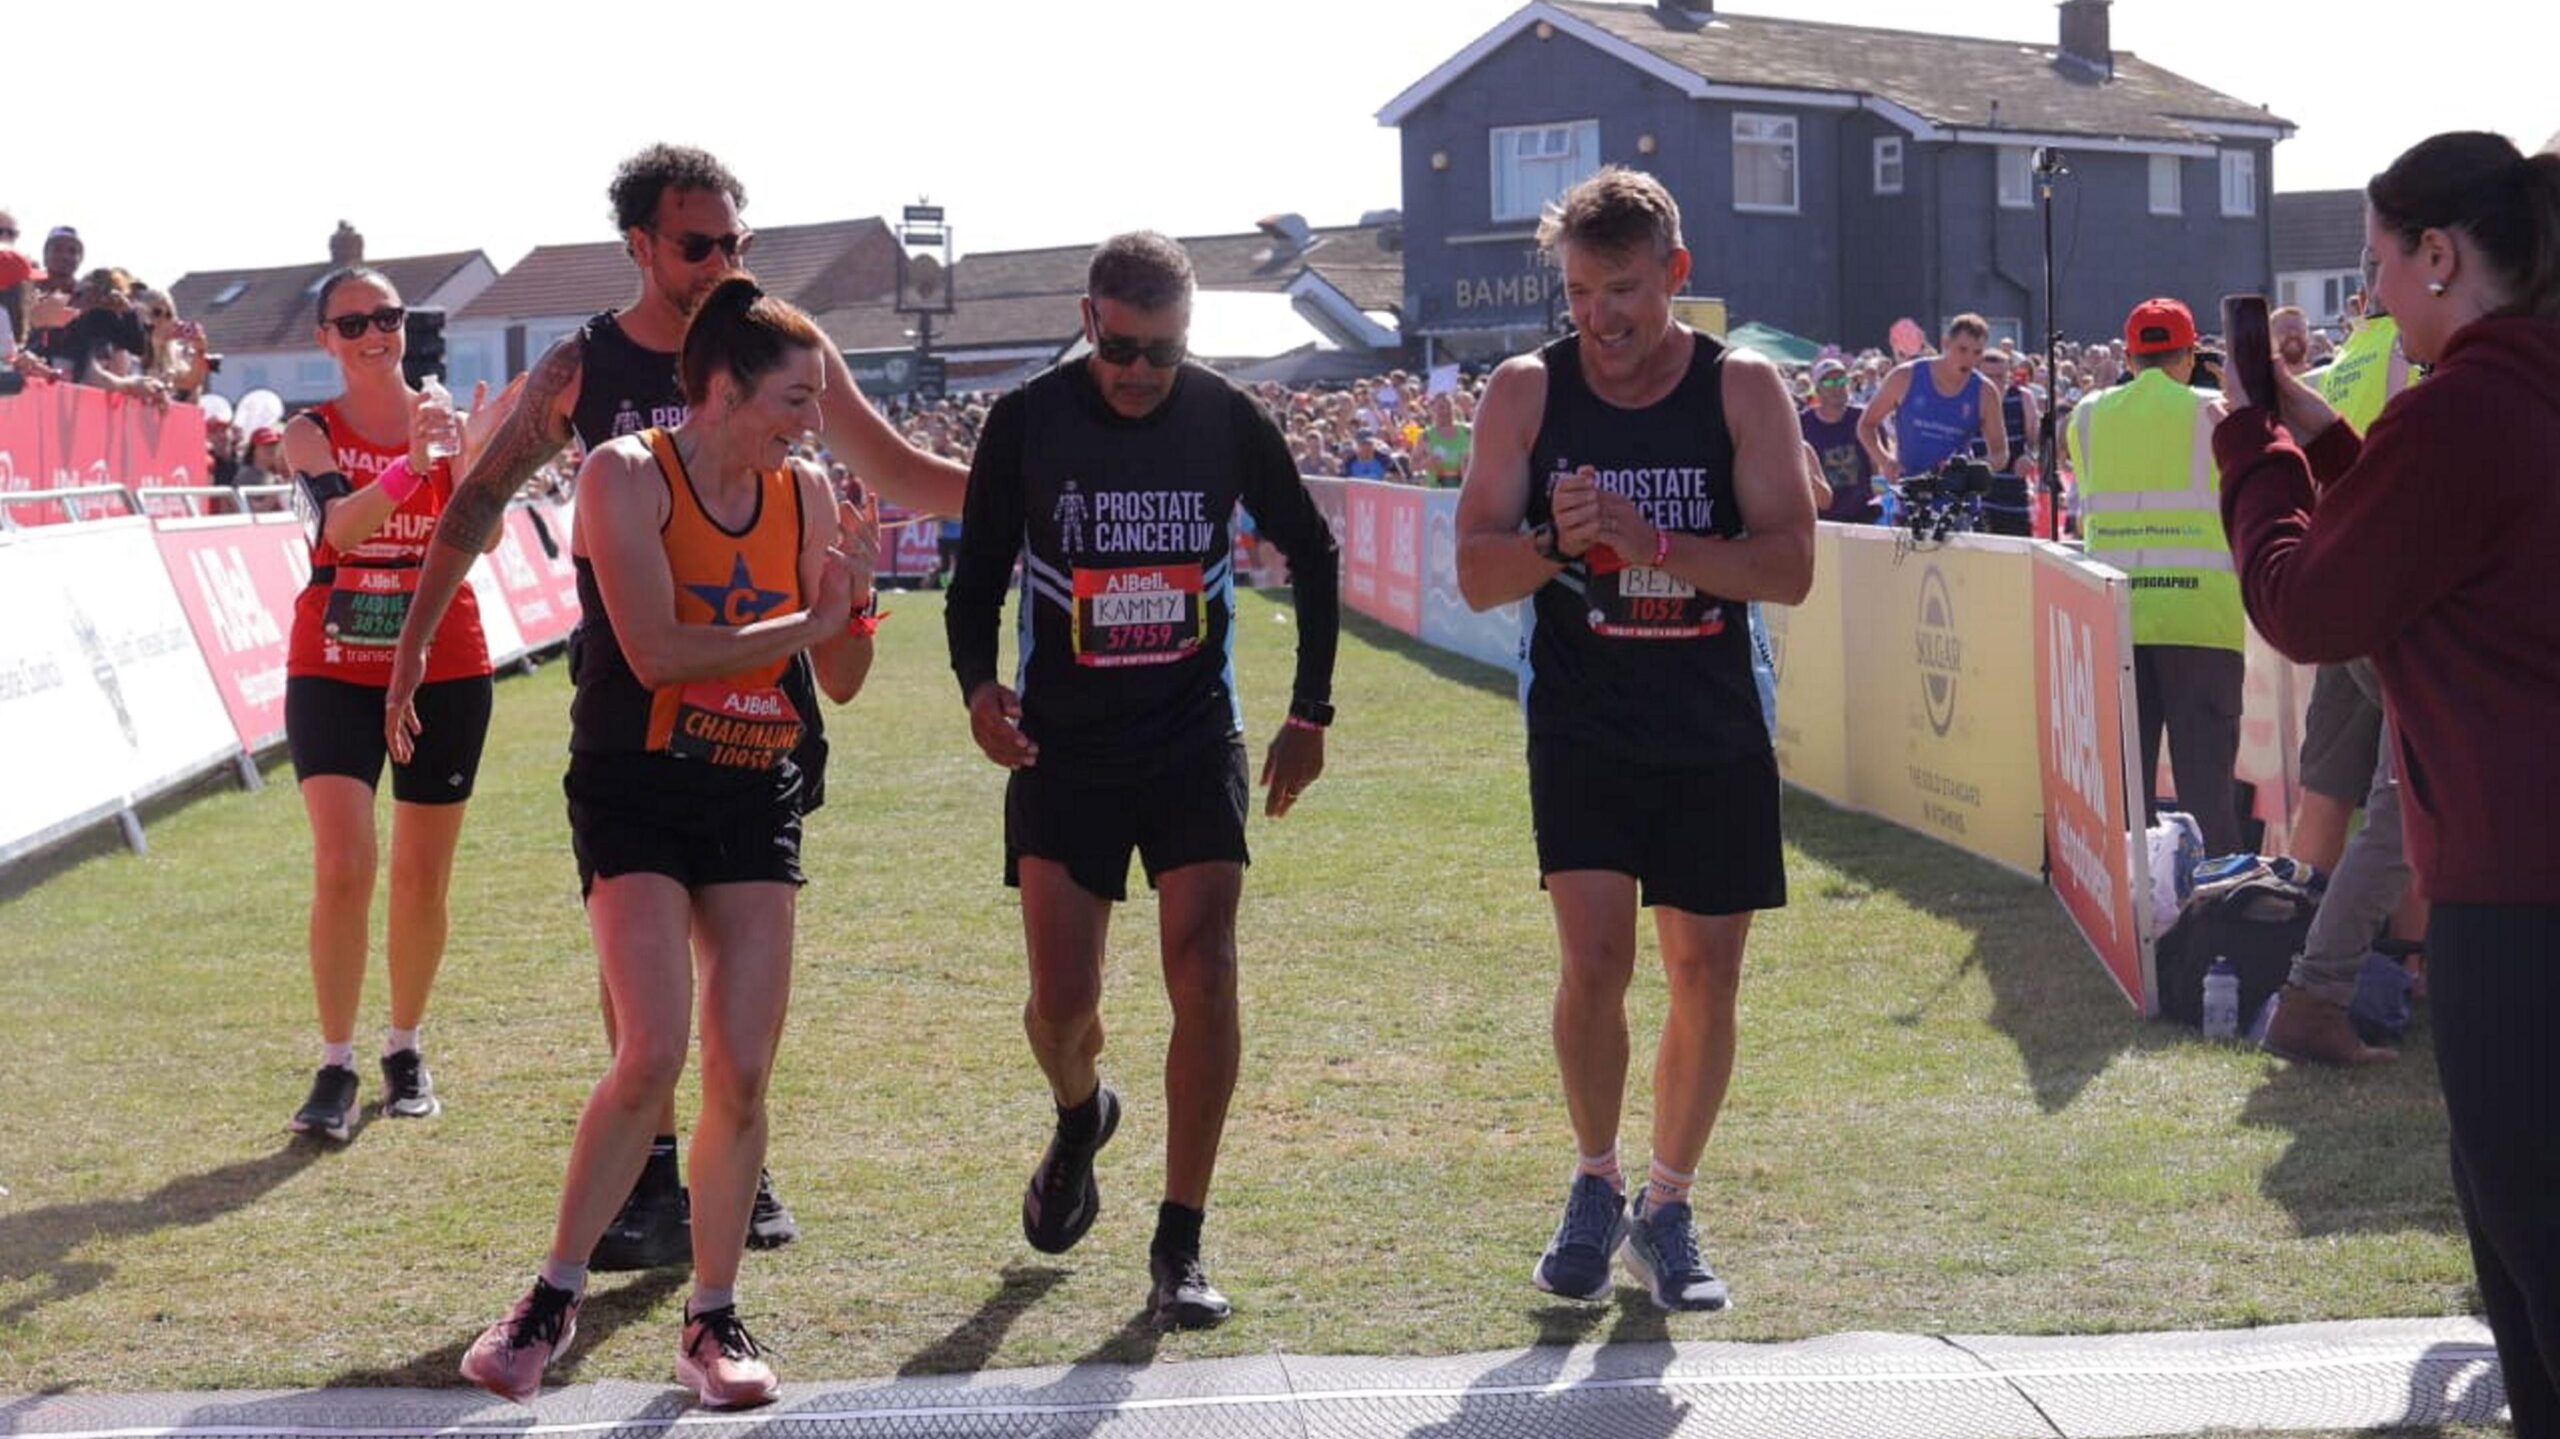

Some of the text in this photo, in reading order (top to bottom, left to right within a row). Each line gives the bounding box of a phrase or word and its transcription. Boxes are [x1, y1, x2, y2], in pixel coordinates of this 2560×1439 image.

[1095, 490, 1206, 522] PROSTATE
[1688, 498, 1714, 530] UK
[1095, 522, 1216, 552] CANCER UK
[724, 588, 757, 625] C
[1098, 595, 1179, 621] KAMMY
[1631, 597, 1684, 620] 1052
[1107, 624, 1174, 651] 57959
[683, 710, 800, 750] CHARMAINE
